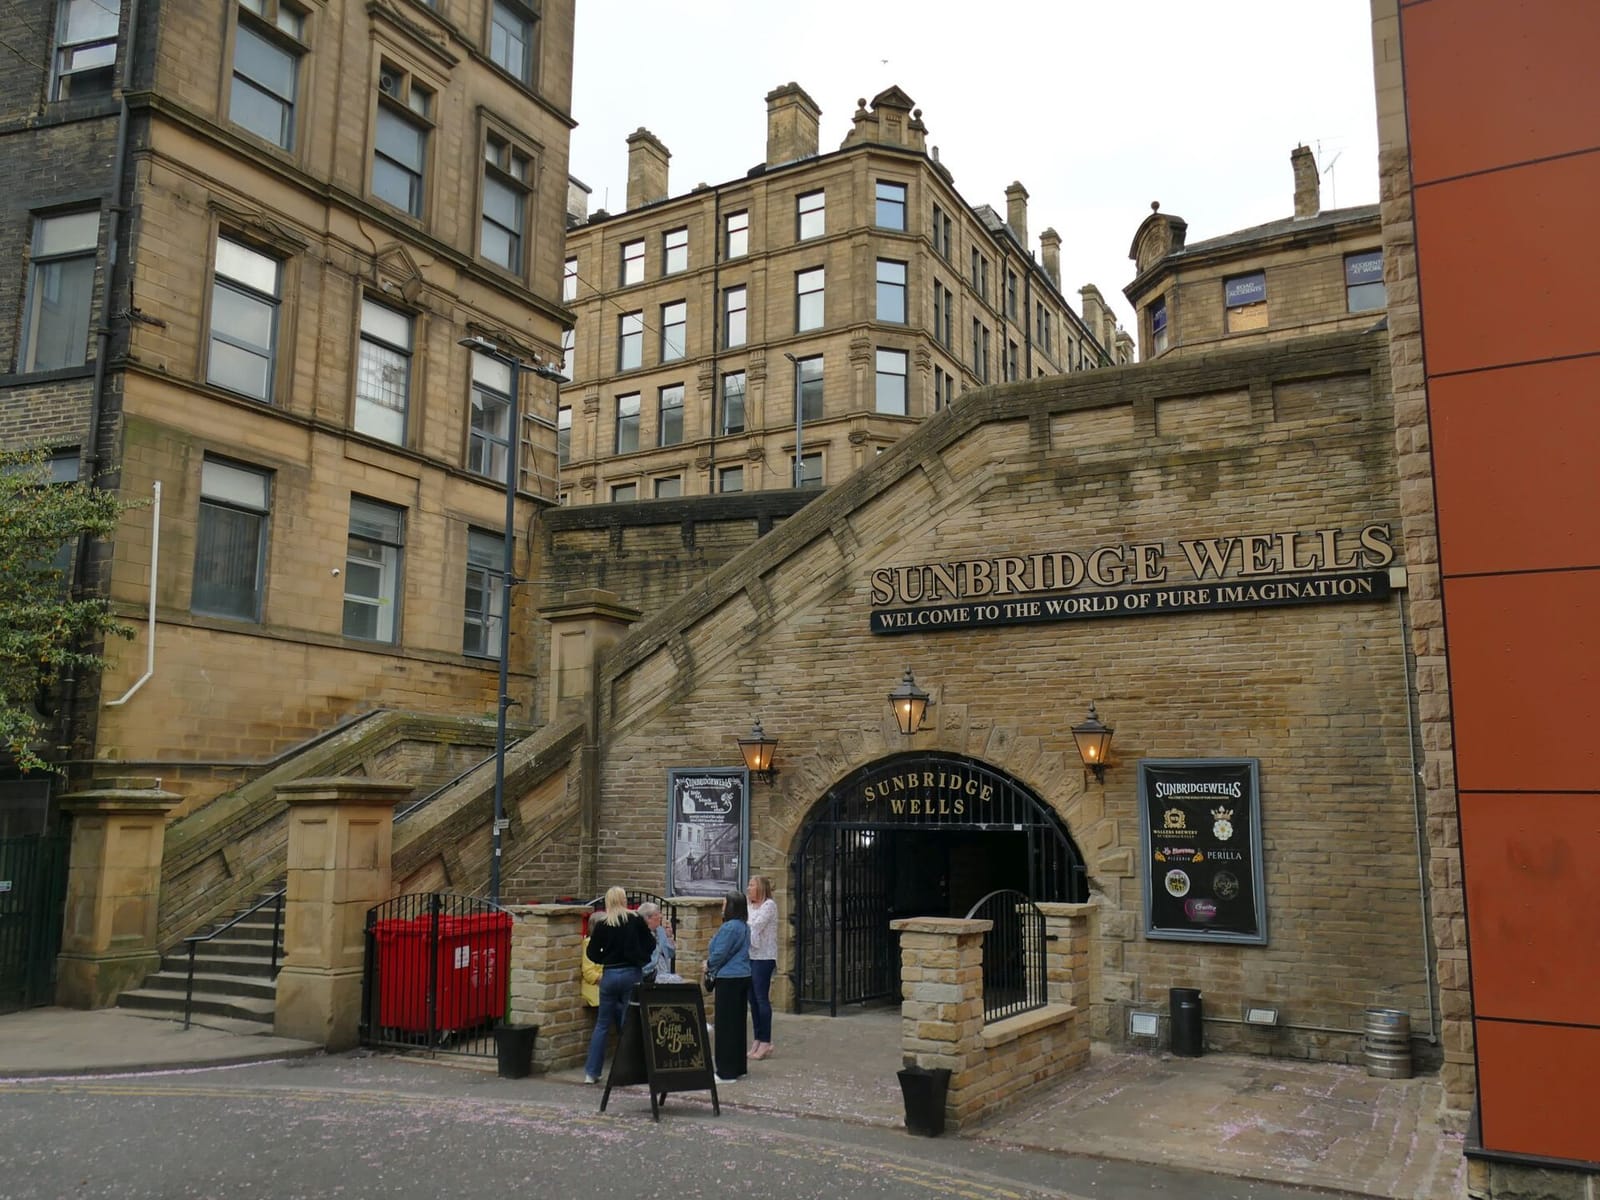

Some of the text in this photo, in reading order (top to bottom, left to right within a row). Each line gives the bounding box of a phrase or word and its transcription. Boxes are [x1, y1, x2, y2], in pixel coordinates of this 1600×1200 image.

[1229, 287, 1262, 297] ACCIDENTS
[1236, 283, 1254, 291] ROAD
[870, 523, 1394, 606] SUNBRIDGE WELLS
[879, 577, 1373, 629] WELCOME TO THE WORLD OF PURE IMAGINATION
[864, 772, 993, 802] SUNBRIDGE
[891, 799, 965, 815] WELLS
[1207, 851, 1242, 860] PERILLA
[656, 1020, 682, 1047] Coffee
[668, 1027, 697, 1053] Booth
